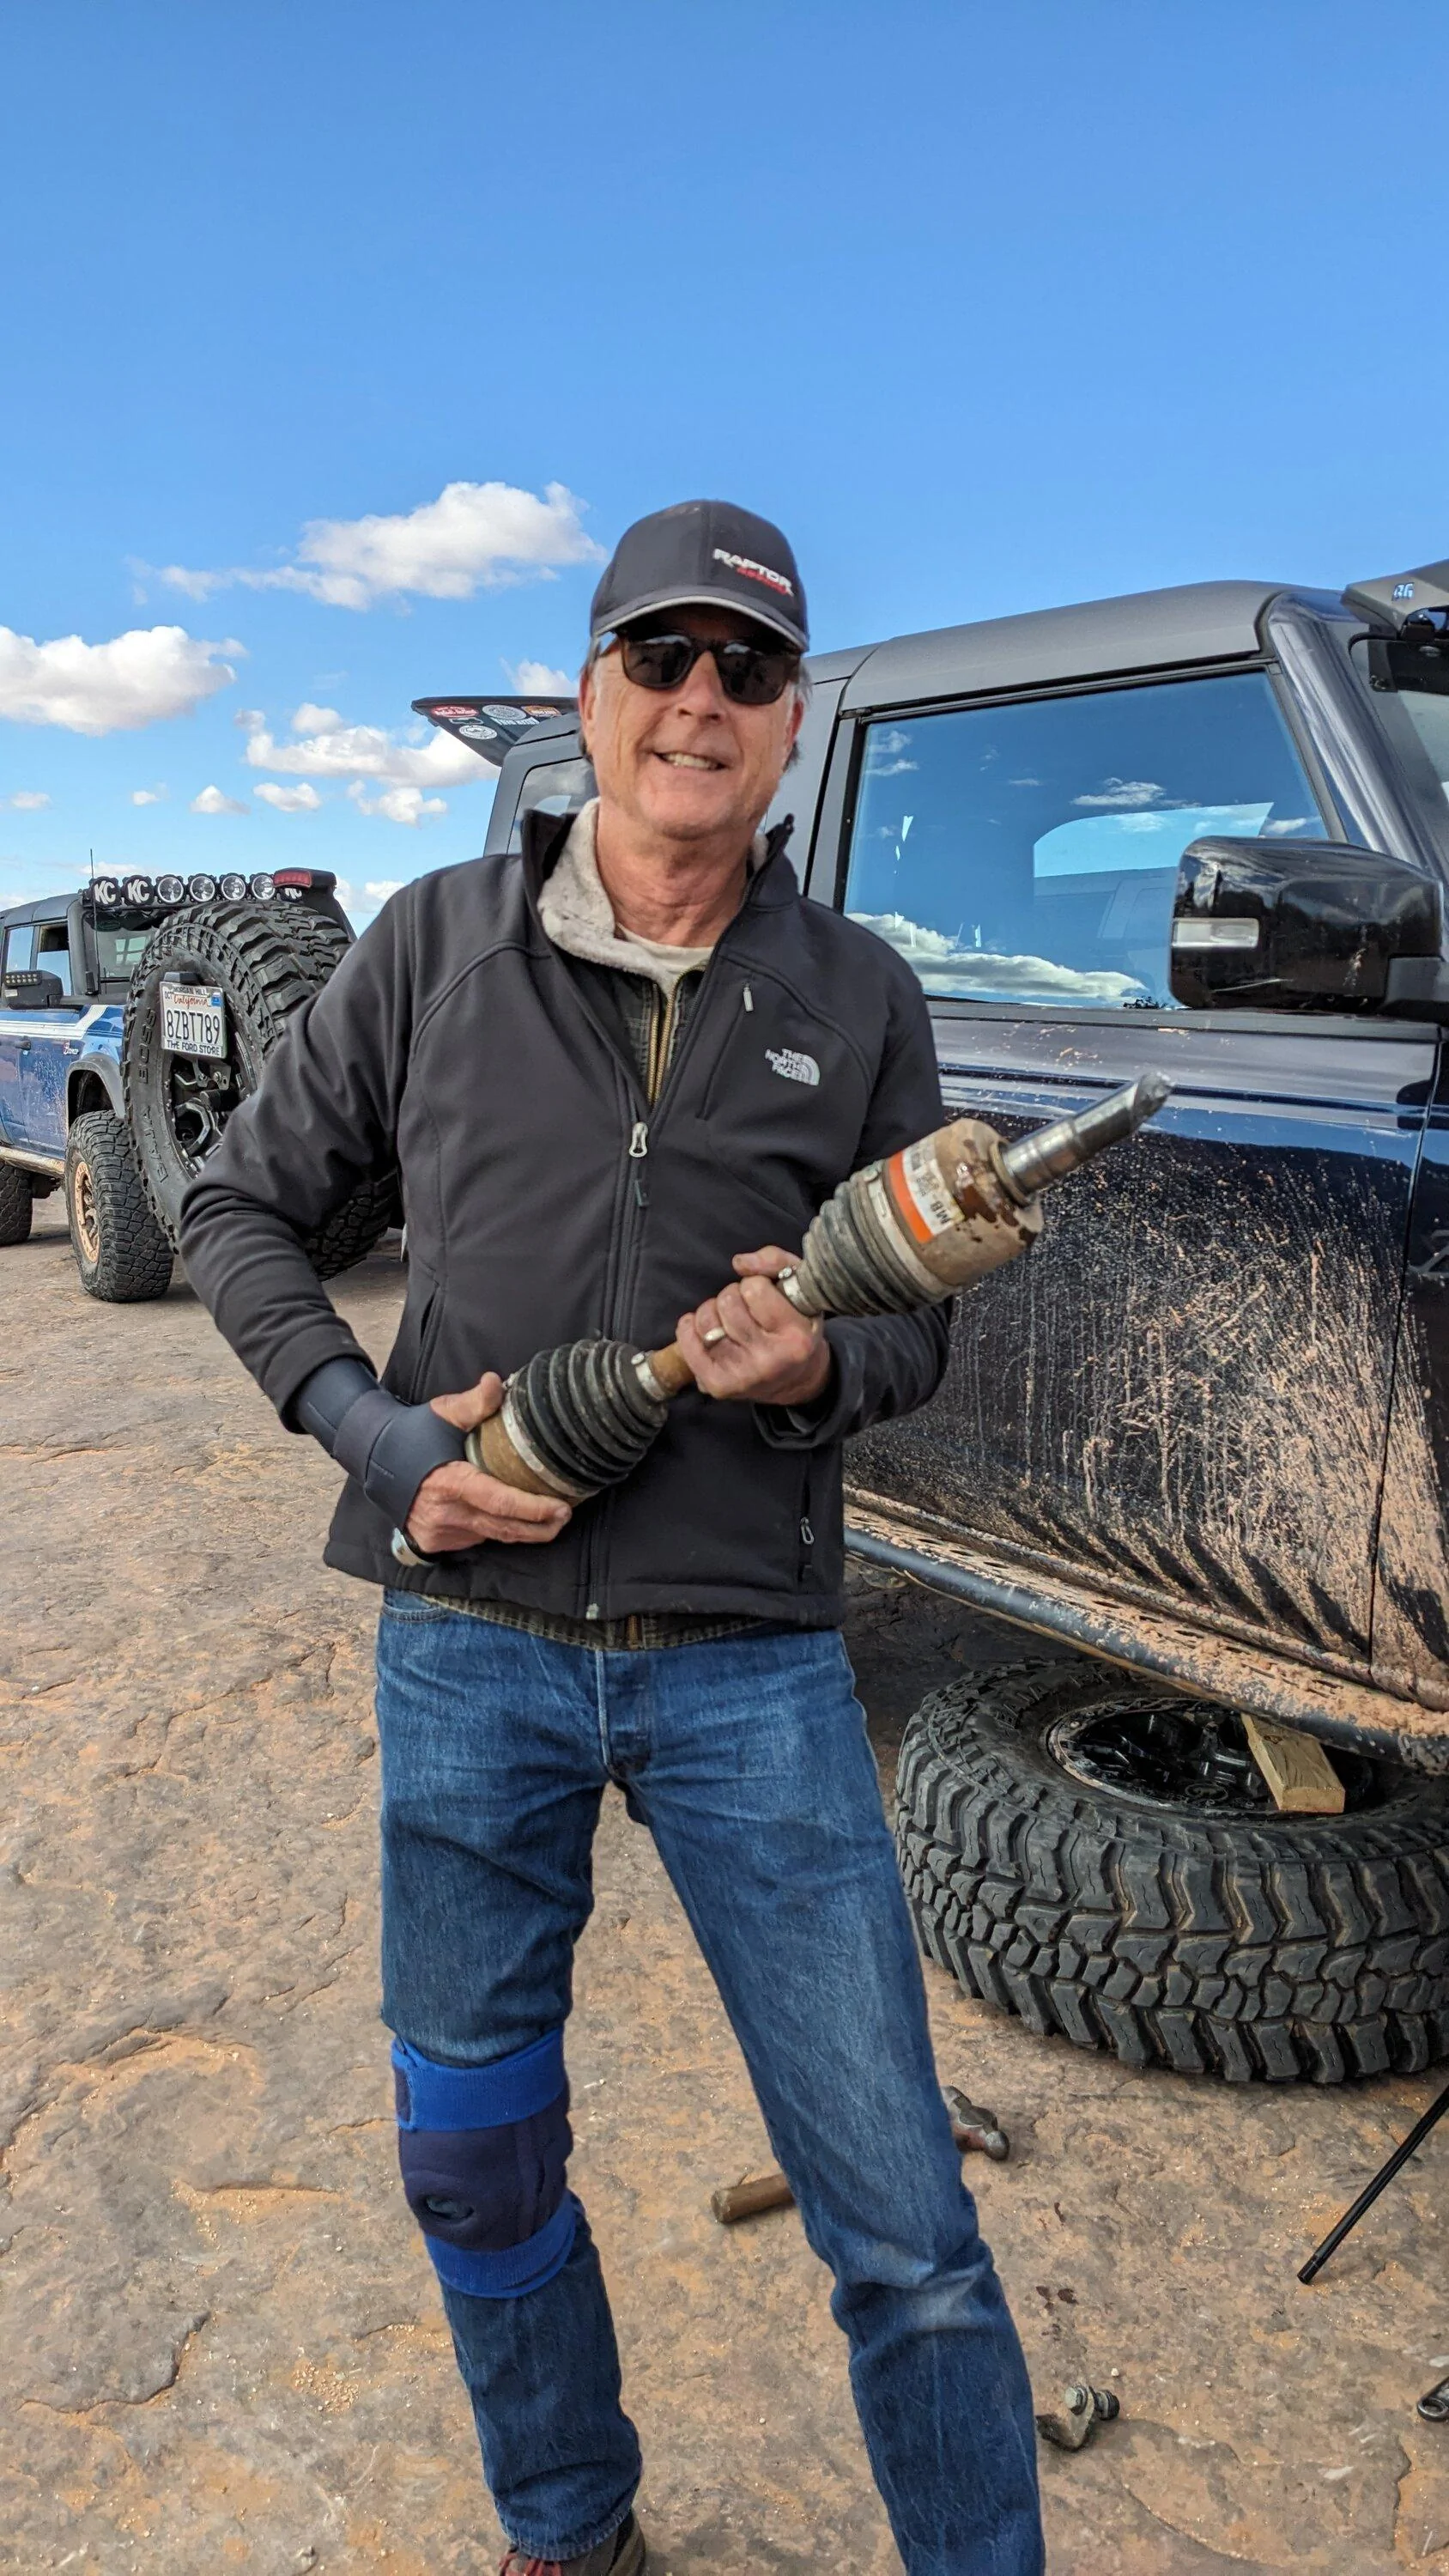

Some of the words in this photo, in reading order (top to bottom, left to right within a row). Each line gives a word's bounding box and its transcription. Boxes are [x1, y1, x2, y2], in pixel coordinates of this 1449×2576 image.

[712, 548, 794, 597] RAPTOR
[94, 880, 117, 905] KC
[127, 878, 149, 903] KC
[166, 1009, 221, 1044] 8ZBT789
[167, 1039, 180, 1049] THE
[181, 1042, 198, 1053] FORD
[198, 1044, 221, 1056] STORE
[782, 1048, 803, 1062] THE
[764, 1049, 803, 1072] NORTH
